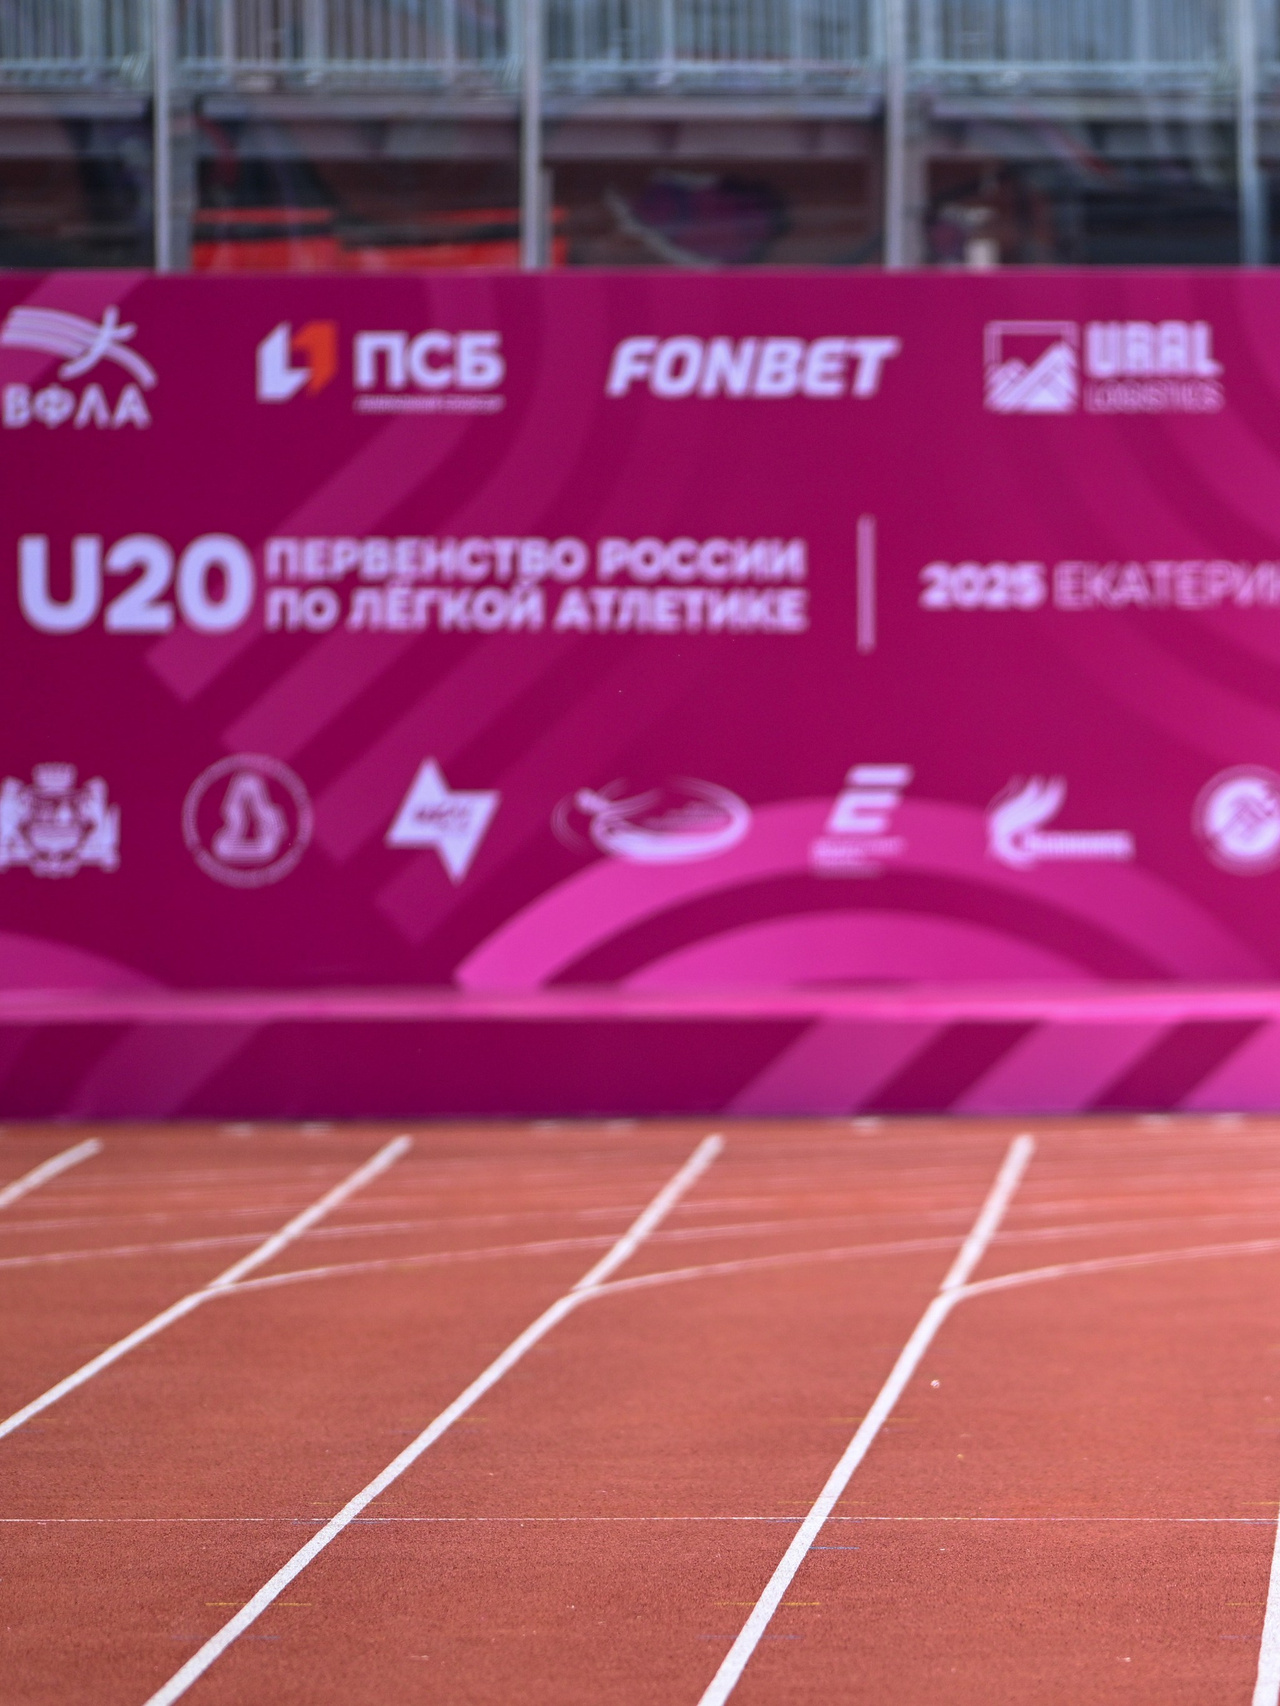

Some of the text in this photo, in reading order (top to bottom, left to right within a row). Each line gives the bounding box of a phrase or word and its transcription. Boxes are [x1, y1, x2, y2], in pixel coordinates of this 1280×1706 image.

[354, 330, 505, 388] ПСБ
[606, 335, 900, 398] FONBET
[1084, 320, 1222, 378] URAL
[2, 382, 153, 430] ВФЛА
[17, 533, 256, 636] U20
[264, 537, 808, 582] ПЕРВЕНСТВО РОССИИ
[920, 562, 1046, 609] 2025
[264, 577, 808, 632] ПО ЛЁГКОЙ АТЛЕТИКЕ
